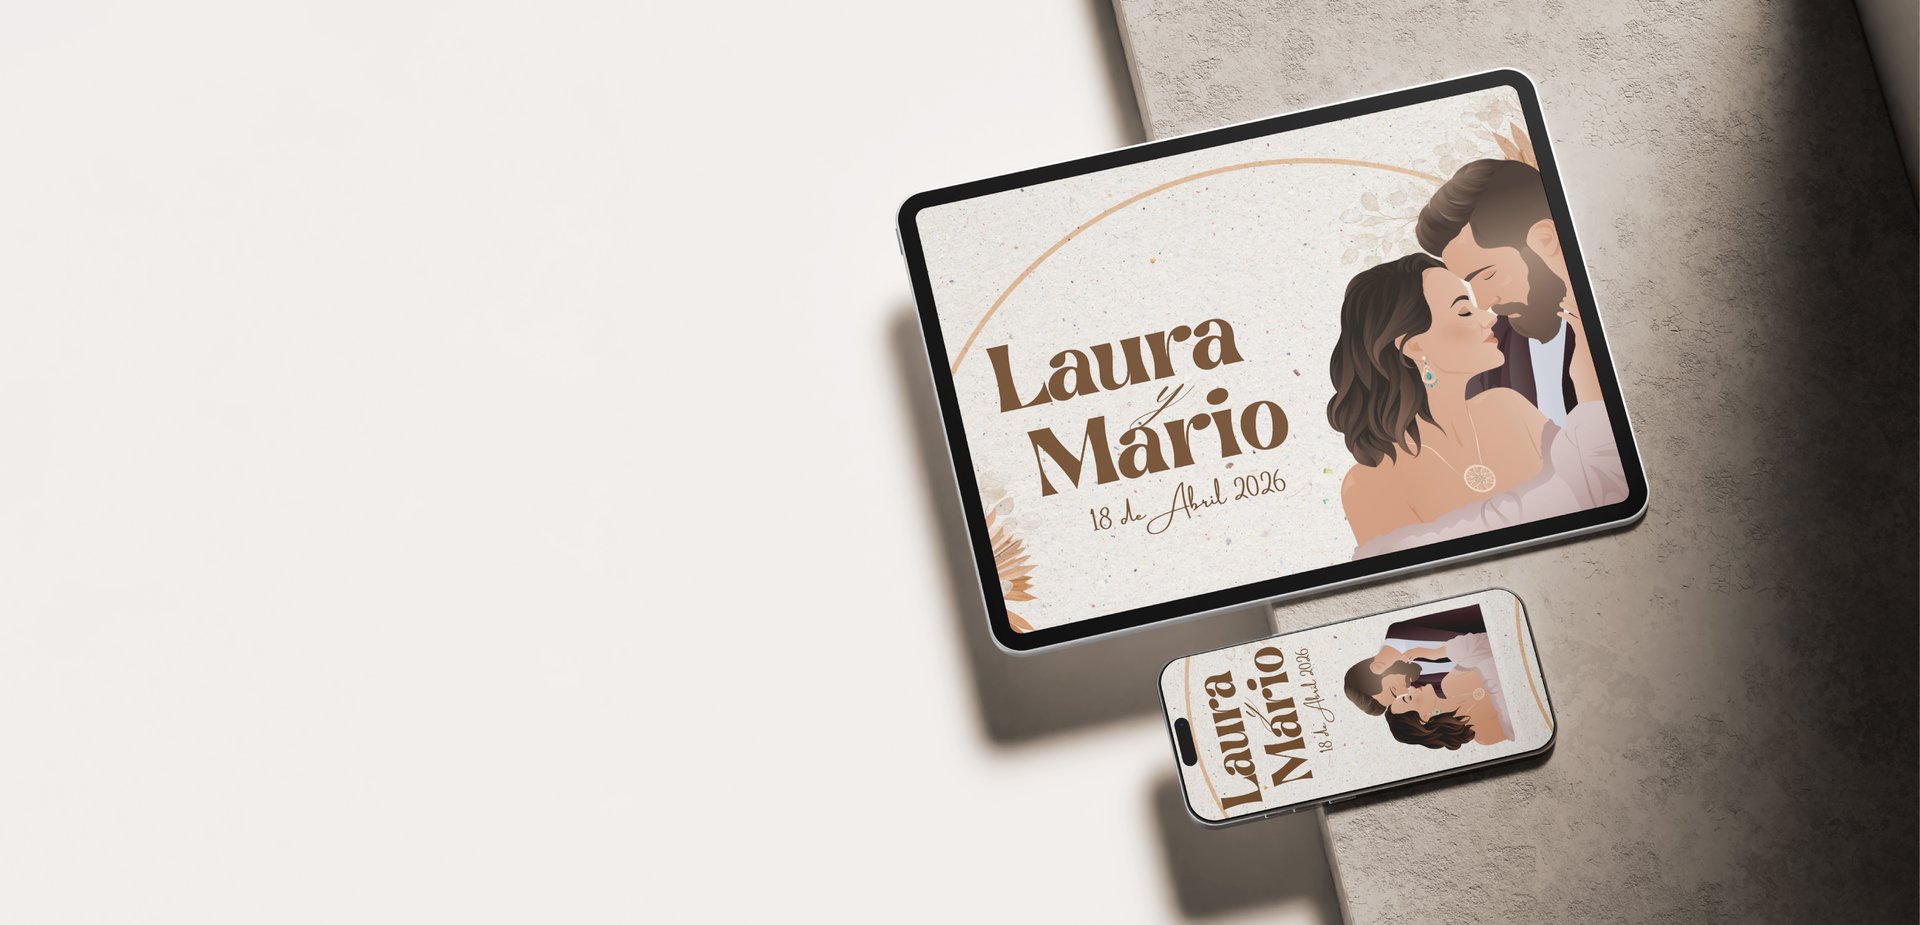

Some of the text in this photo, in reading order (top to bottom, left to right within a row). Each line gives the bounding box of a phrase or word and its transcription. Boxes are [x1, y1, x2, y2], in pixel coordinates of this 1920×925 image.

[986, 318, 1245, 413] Laura
[1129, 383, 1195, 429] y
[1027, 387, 1289, 497] Mario
[1089, 468, 1287, 534] 18 de Abril 2026
[1204, 670, 1263, 810] Laura
[1246, 646, 1314, 787] Mario
[1294, 648, 1335, 753] 18 de Abril 2026
